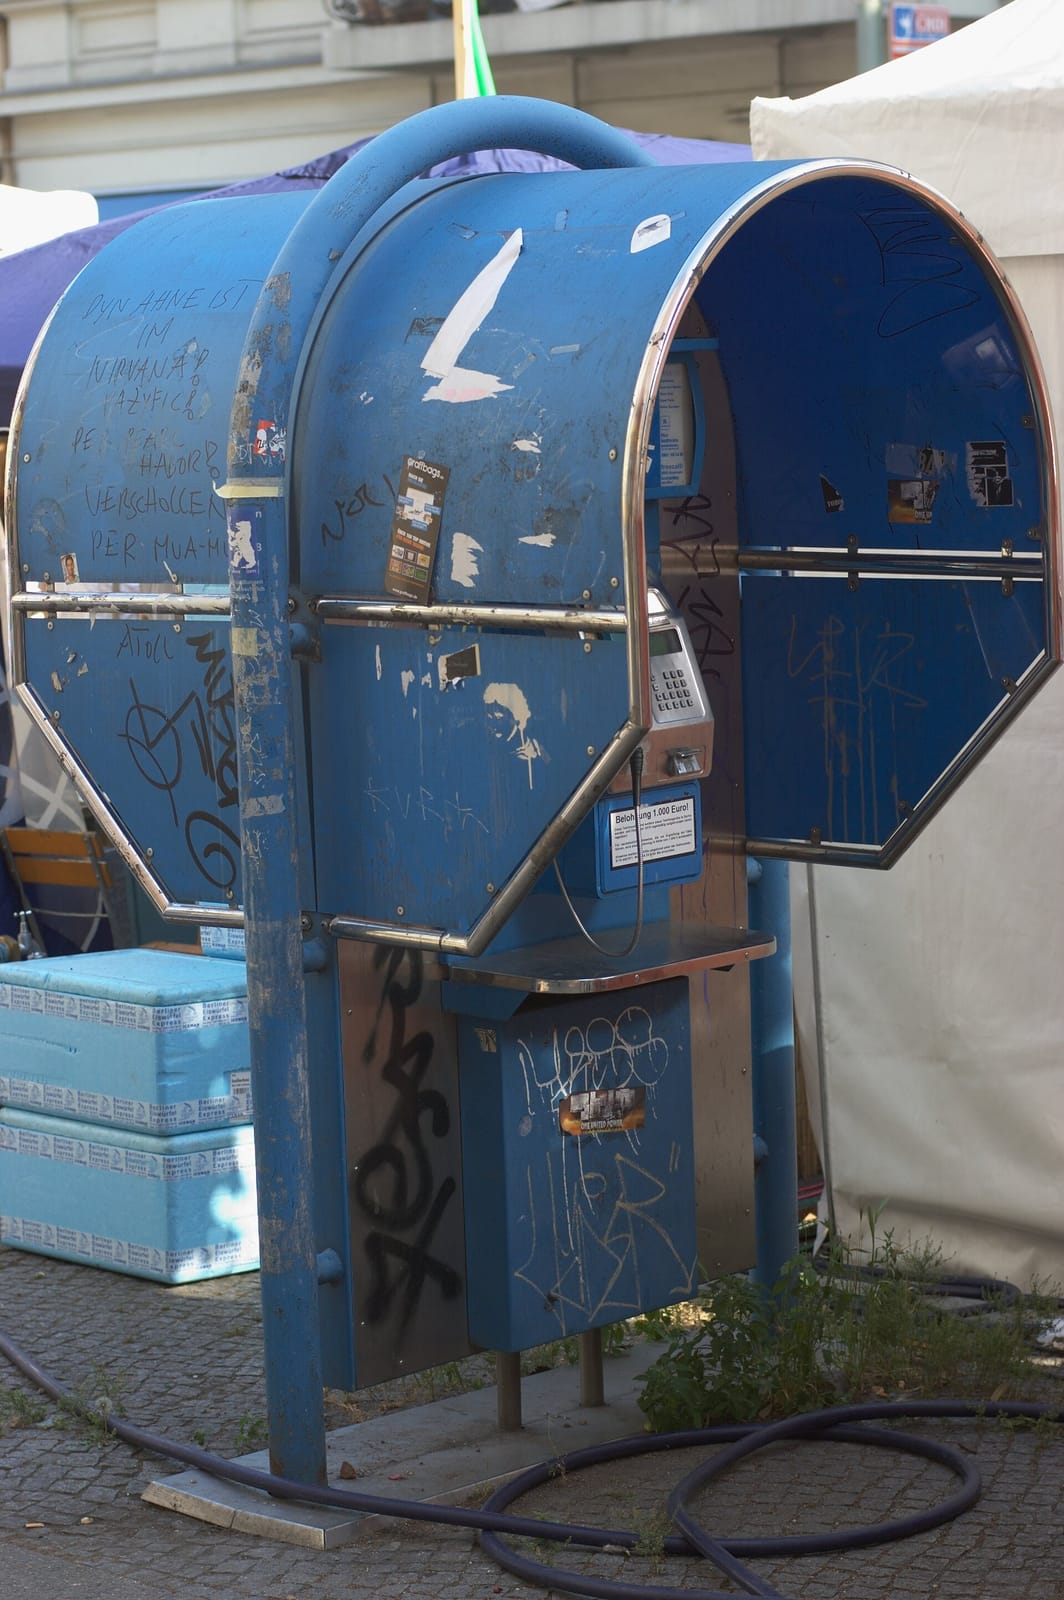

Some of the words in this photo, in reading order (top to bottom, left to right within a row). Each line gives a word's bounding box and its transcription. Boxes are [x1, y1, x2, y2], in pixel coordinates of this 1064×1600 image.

[91, 530, 136, 567] PER
[615, 811, 651, 824] Belohung
[653, 806, 670, 817] 1.000
[671, 802, 689, 814] Euro!
